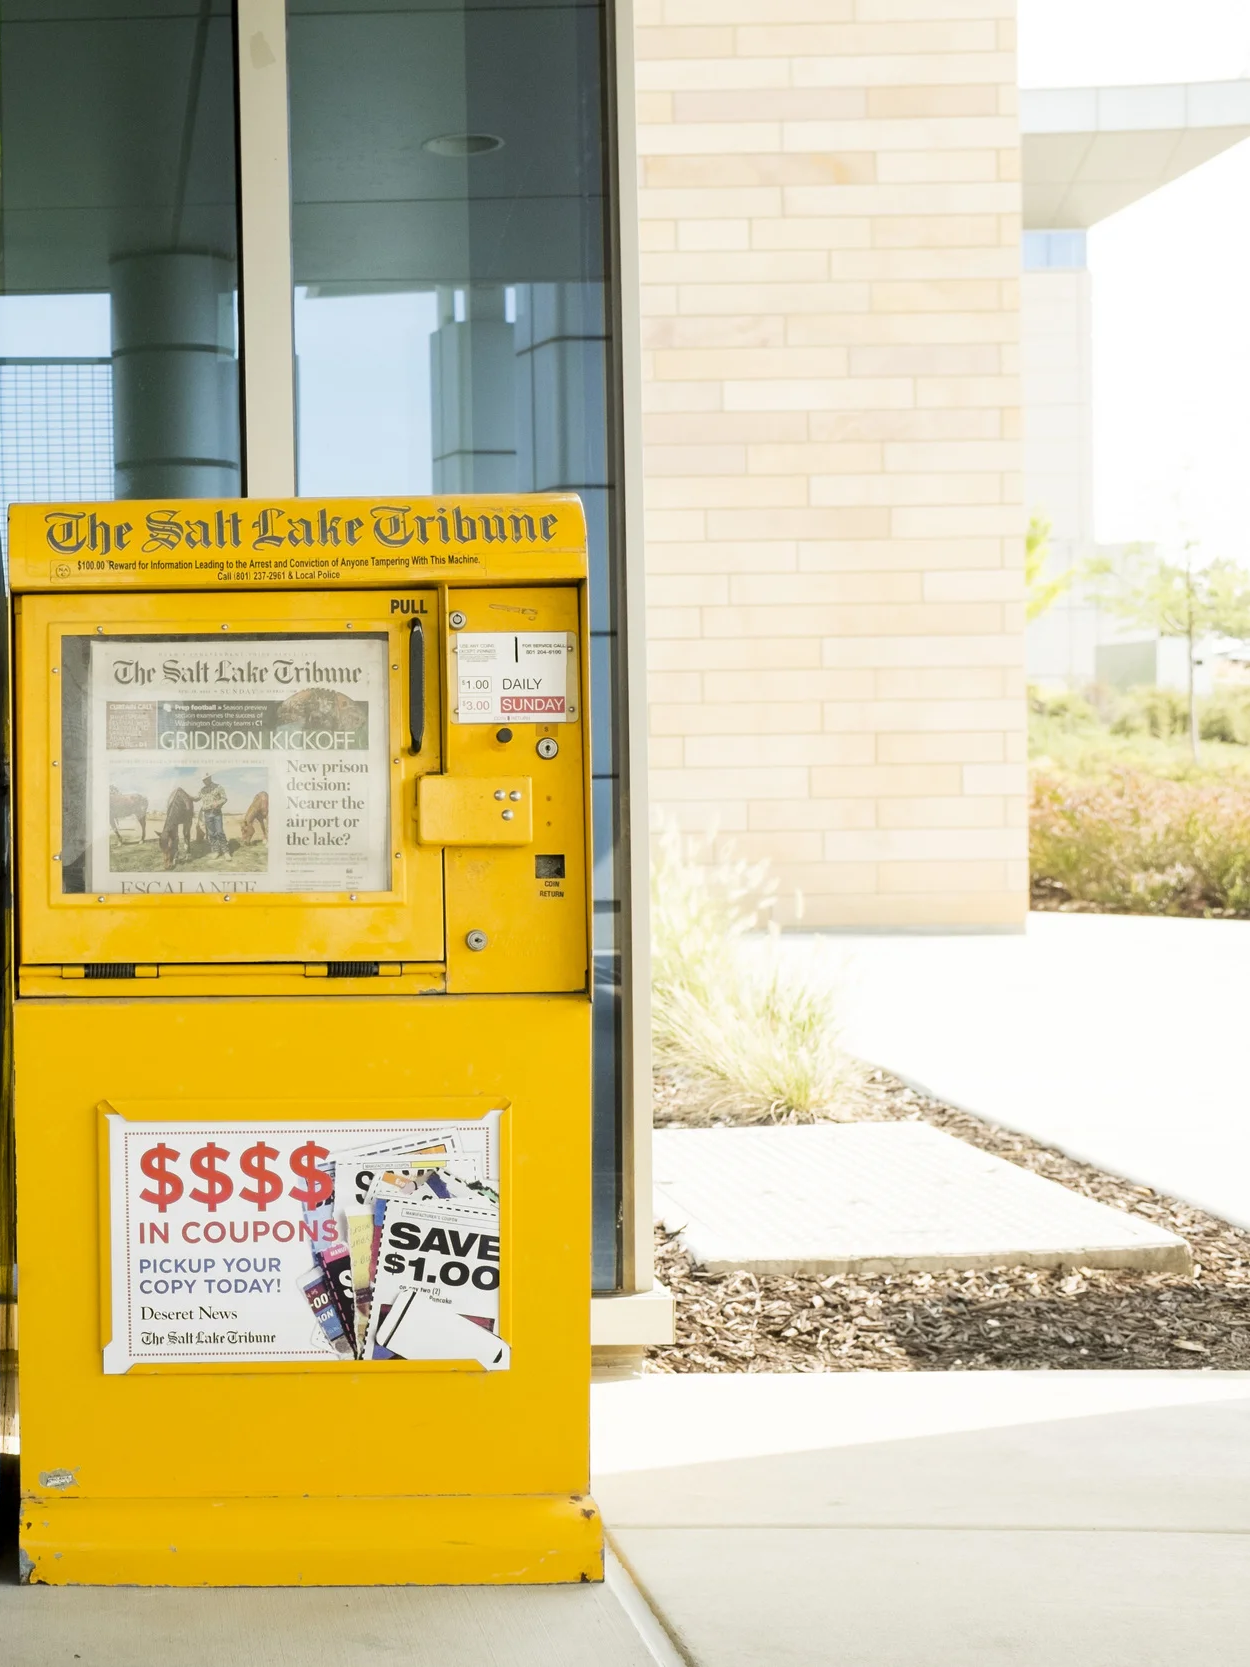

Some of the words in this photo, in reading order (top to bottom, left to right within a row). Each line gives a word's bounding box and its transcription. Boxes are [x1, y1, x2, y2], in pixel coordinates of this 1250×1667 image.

[44, 511, 133, 555] The
[141, 509, 243, 553] Salt
[251, 508, 365, 550] Lake
[370, 505, 558, 549] Tribune
[77, 560, 105, 571] $100.00
[109, 560, 136, 570] Reward
[138, 560, 149, 570] for
[150, 559, 193, 570] Information
[194, 559, 224, 572] Leading
[226, 559, 233, 569] to
[235, 559, 247, 569] the
[249, 558, 272, 569] Arrest
[273, 558, 288, 568] and
[289, 557, 329, 568] Conviction
[331, 557, 339, 567] of
[340, 557, 369, 569] Anyone
[371, 556, 410, 569] Tampering
[411, 555, 429, 566] With
[430, 555, 446, 566] This
[448, 554, 481, 565] Machine.
[217, 571, 232, 581] Call
[233, 571, 251, 581] (801)
[253, 571, 286, 580] 237-2961
[288, 571, 294, 580] &
[295, 570, 315, 580] Local
[317, 570, 340, 580] Police
[390, 599, 428, 614] PULL
[113, 659, 156, 686] The
[161, 659, 209, 684] Salt
[214, 659, 268, 683] Lake
[272, 659, 362, 684] Tribune
[461, 680, 489, 689] $1.00
[502, 678, 543, 690] DAILY
[174, 704, 190, 712] Prep
[191, 703, 217, 711] football
[244, 704, 268, 712] preview
[462, 701, 490, 710] $3.00
[502, 698, 564, 711] SUNDAY
[174, 720, 210, 728] Washington
[211, 720, 232, 728] County
[159, 730, 262, 750] GRIDIRON
[269, 730, 355, 750] KICKOFF
[286, 759, 319, 773] New
[322, 759, 369, 776] prison
[286, 777, 351, 791] decision:
[286, 796, 339, 809] Nearer
[341, 796, 365, 809] the
[286, 814, 340, 831] airport
[343, 817, 360, 828] or
[286, 832, 310, 845] the
[313, 832, 351, 845] lake?
[121, 881, 257, 894] ESCALANTE
[539, 890, 564, 898] RETURN
[139, 1140, 334, 1213] $$$$
[139, 1222, 169, 1244] IN
[181, 1219, 339, 1244] COUPONS
[388, 1221, 500, 1262] SAVE
[139, 1258, 216, 1274] PICKUP
[222, 1257, 282, 1273] YOUR
[383, 1252, 500, 1291] $1.00
[139, 1279, 197, 1294] COPY
[204, 1278, 282, 1294] TODAY!
[140, 1306, 194, 1320] Deseret
[198, 1305, 238, 1320] News
[140, 1331, 165, 1346] The
[167, 1331, 193, 1345] Salt
[195, 1330, 225, 1345] Lake
[226, 1330, 276, 1345] Tribune
